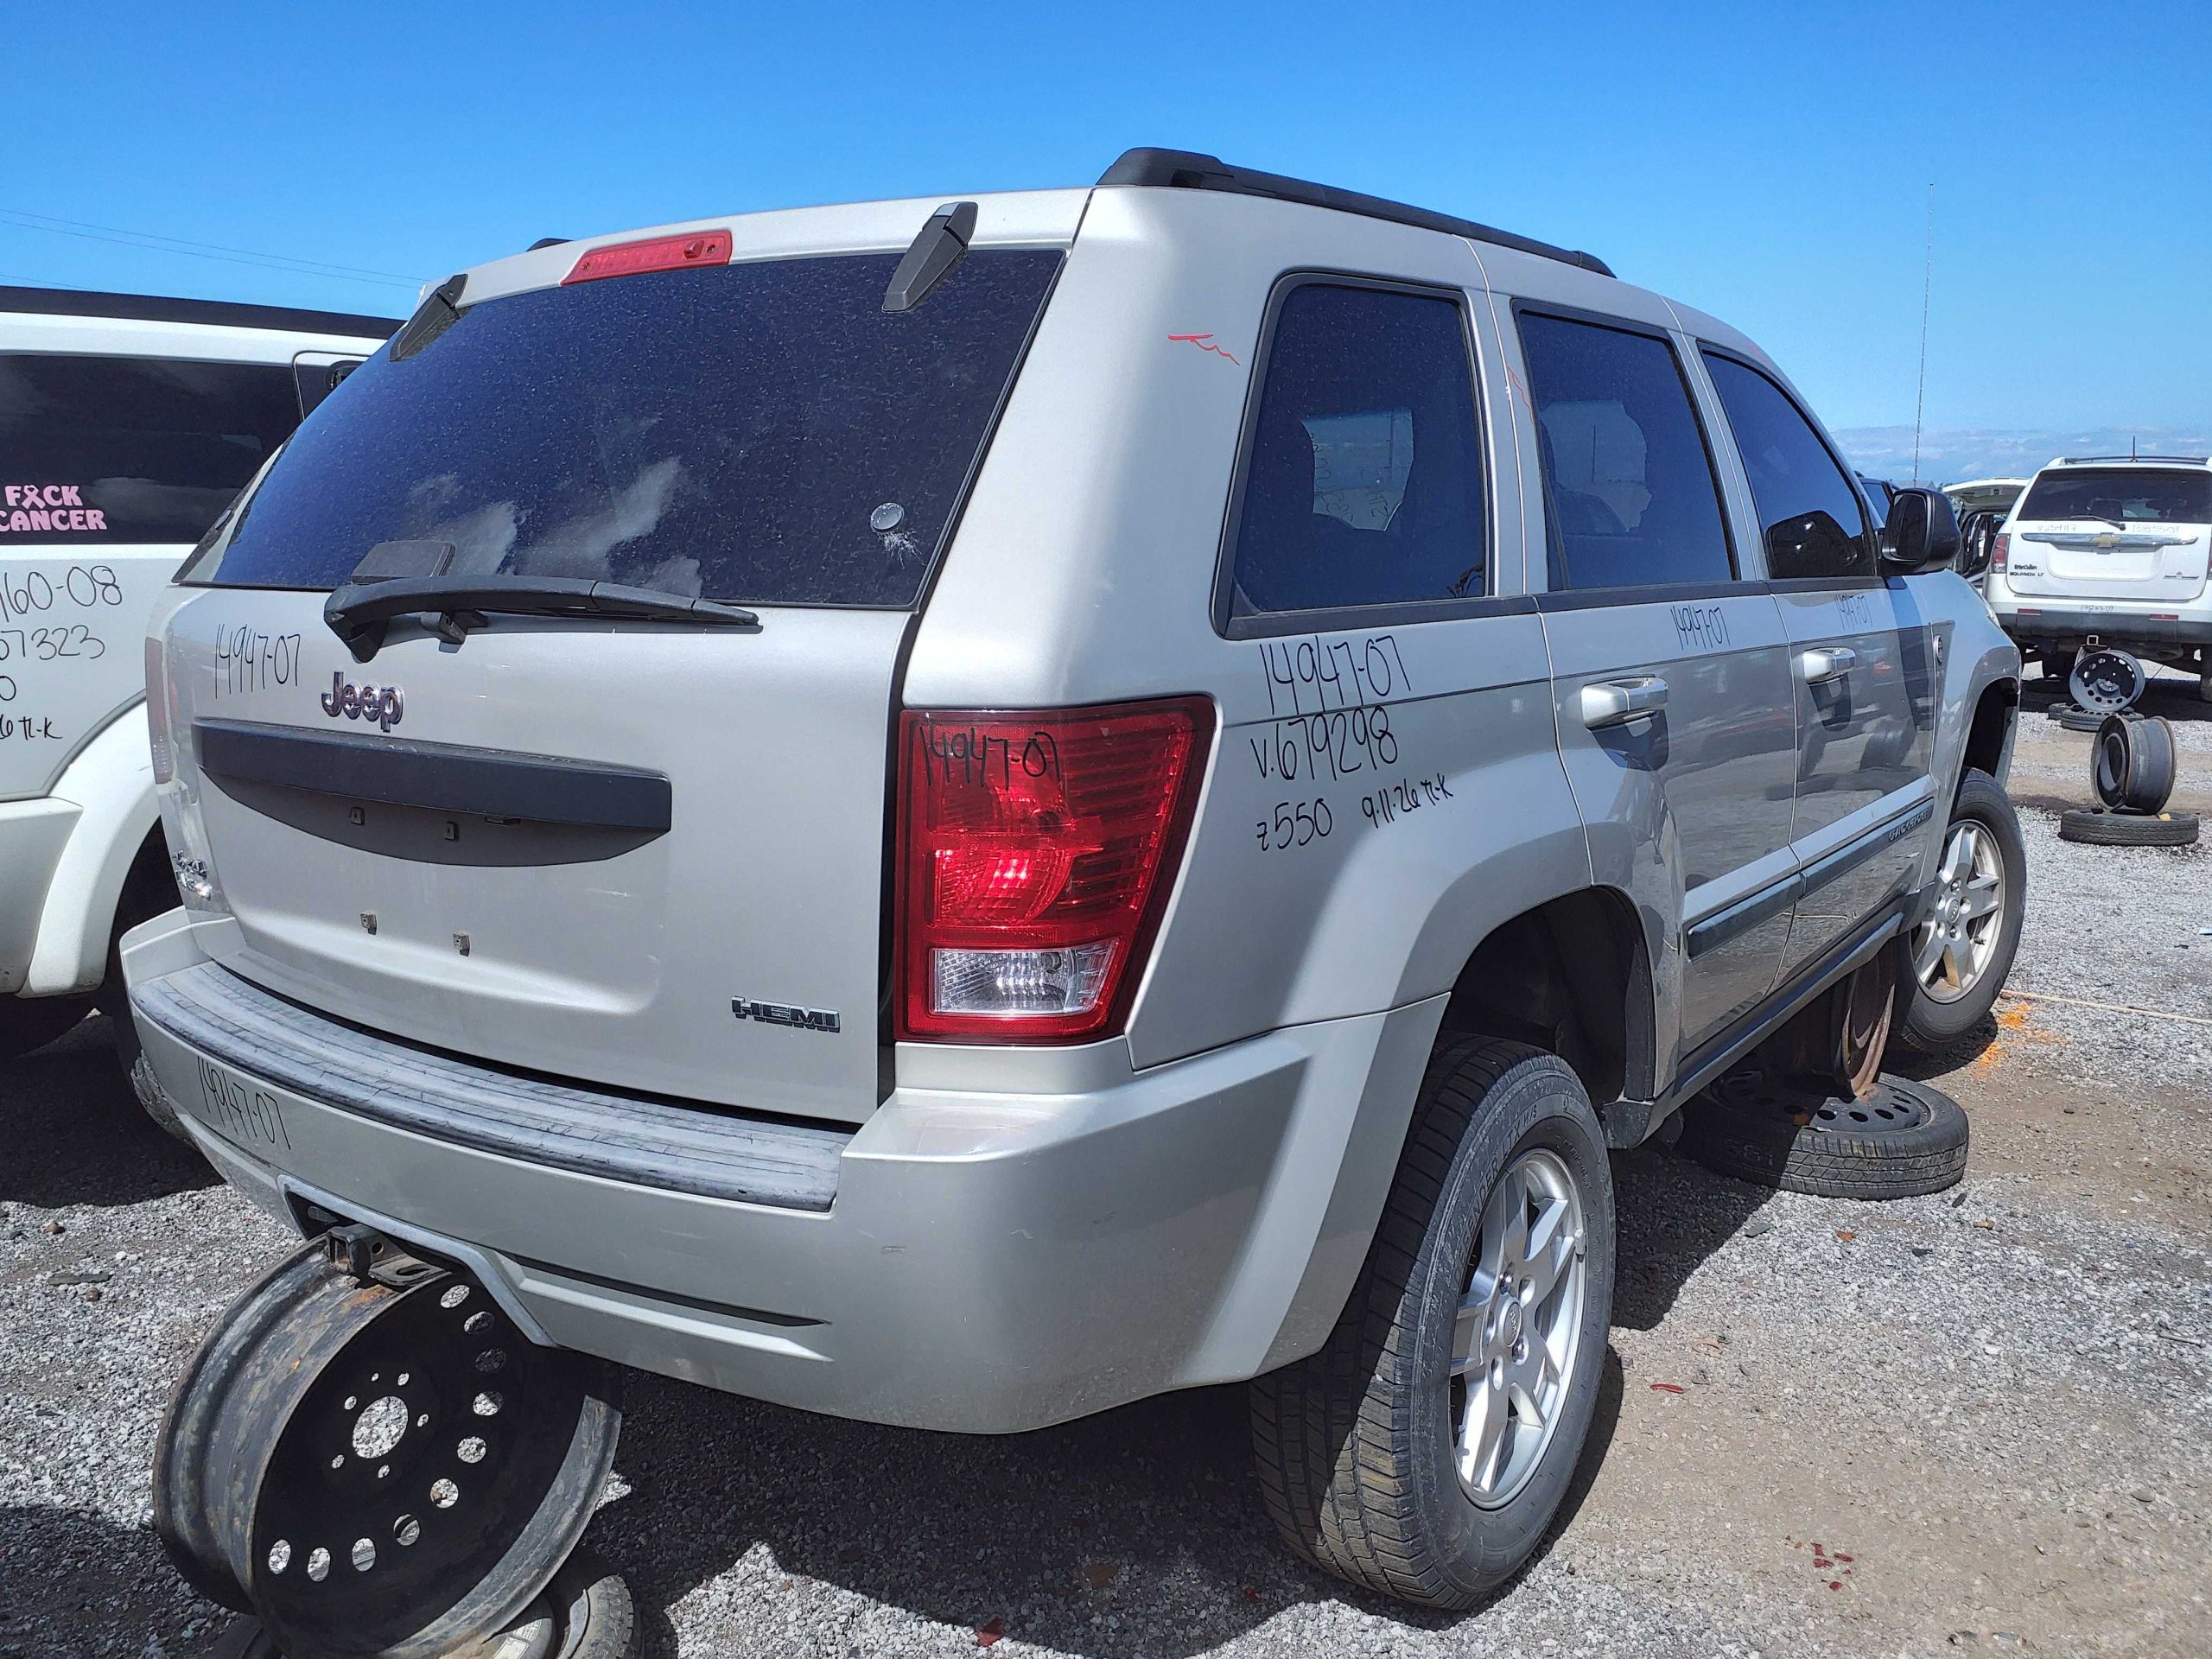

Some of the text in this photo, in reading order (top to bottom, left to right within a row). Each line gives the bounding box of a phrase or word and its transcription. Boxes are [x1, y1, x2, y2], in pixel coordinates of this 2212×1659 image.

[0, 565, 123, 622] 60-08
[214, 623, 302, 700] 14947-07
[1259, 634, 1412, 715] 14947-07
[321, 670, 404, 734] Jeep
[731, 995, 841, 1033] HEMI
